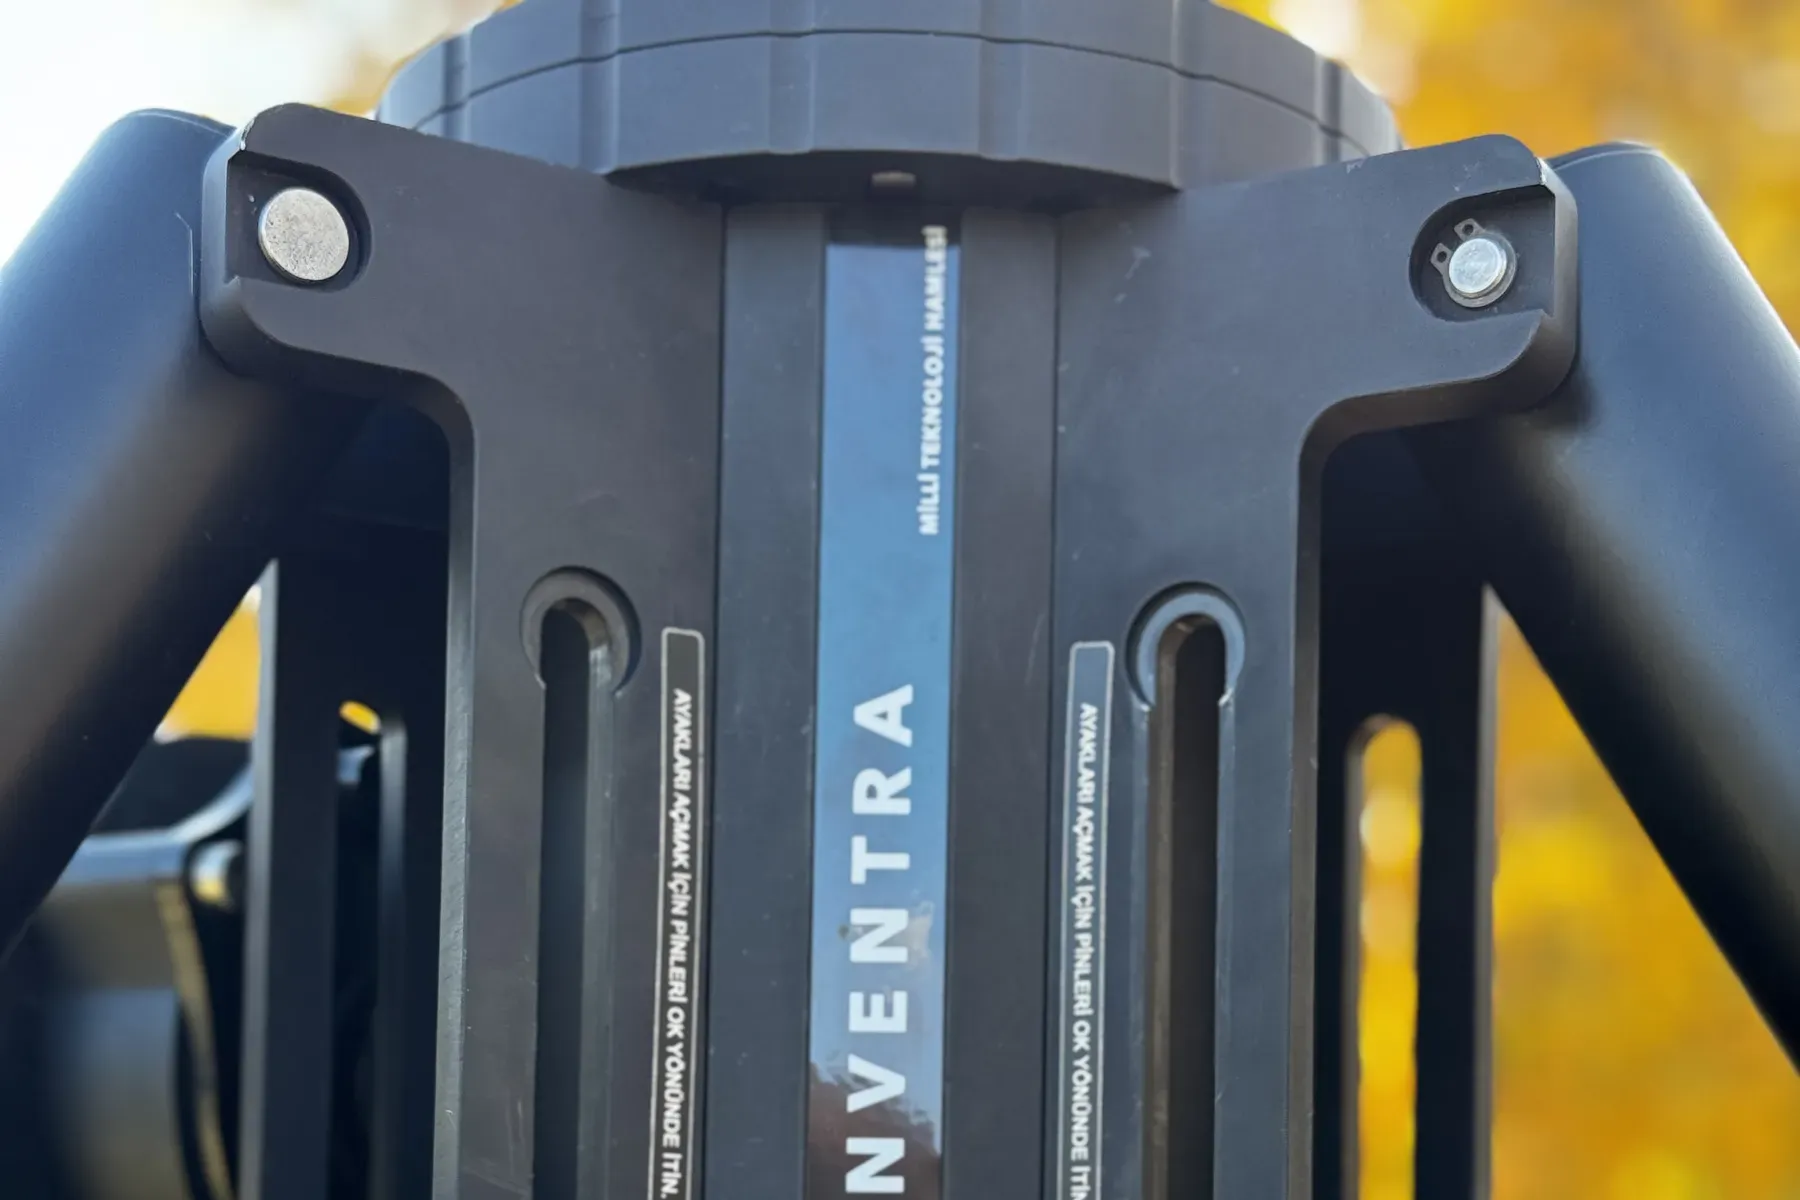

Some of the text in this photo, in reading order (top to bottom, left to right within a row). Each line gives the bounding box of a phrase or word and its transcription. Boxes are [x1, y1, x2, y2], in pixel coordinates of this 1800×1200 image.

[918, 336, 945, 470] TEKNOLOJİ
[916, 473, 941, 535] MİLLİ
[1076, 702, 1099, 803] AYAKLARI
[1072, 806, 1097, 882] AÇMAK
[660, 688, 692, 1199] AYAKLARI AÇMAK İÇİN PİNLERİ OK YÖNÜNDE İTİN.
[1071, 885, 1096, 929] İÇİN
[1070, 933, 1095, 1016] PİNLERİ
[1073, 1020, 1093, 1052] OK
[1071, 1055, 1093, 1161] YÖNÜNDE
